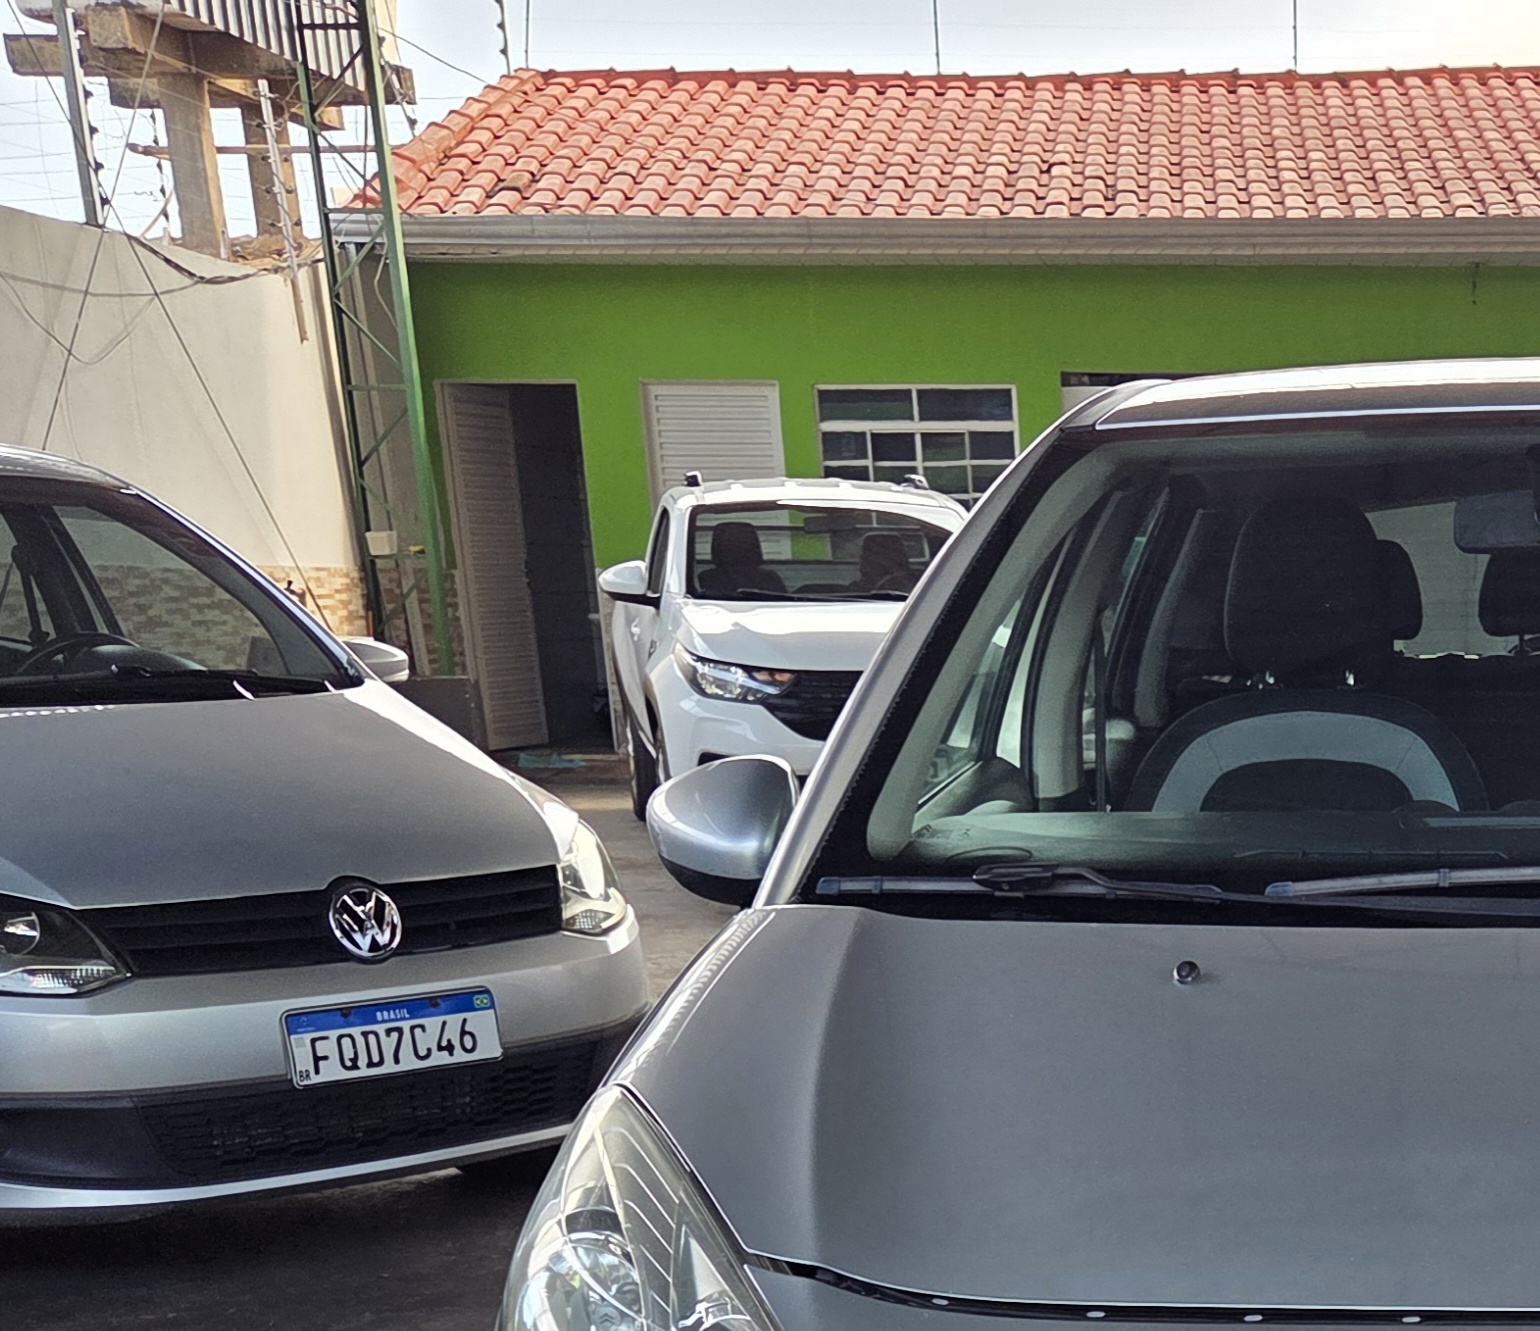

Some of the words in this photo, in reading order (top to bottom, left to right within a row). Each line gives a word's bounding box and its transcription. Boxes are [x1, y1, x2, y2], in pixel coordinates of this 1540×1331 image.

[376, 1008, 410, 1022] BRASIL
[309, 1017, 478, 1076] FQD7C46
[298, 1069, 312, 1082] BR
